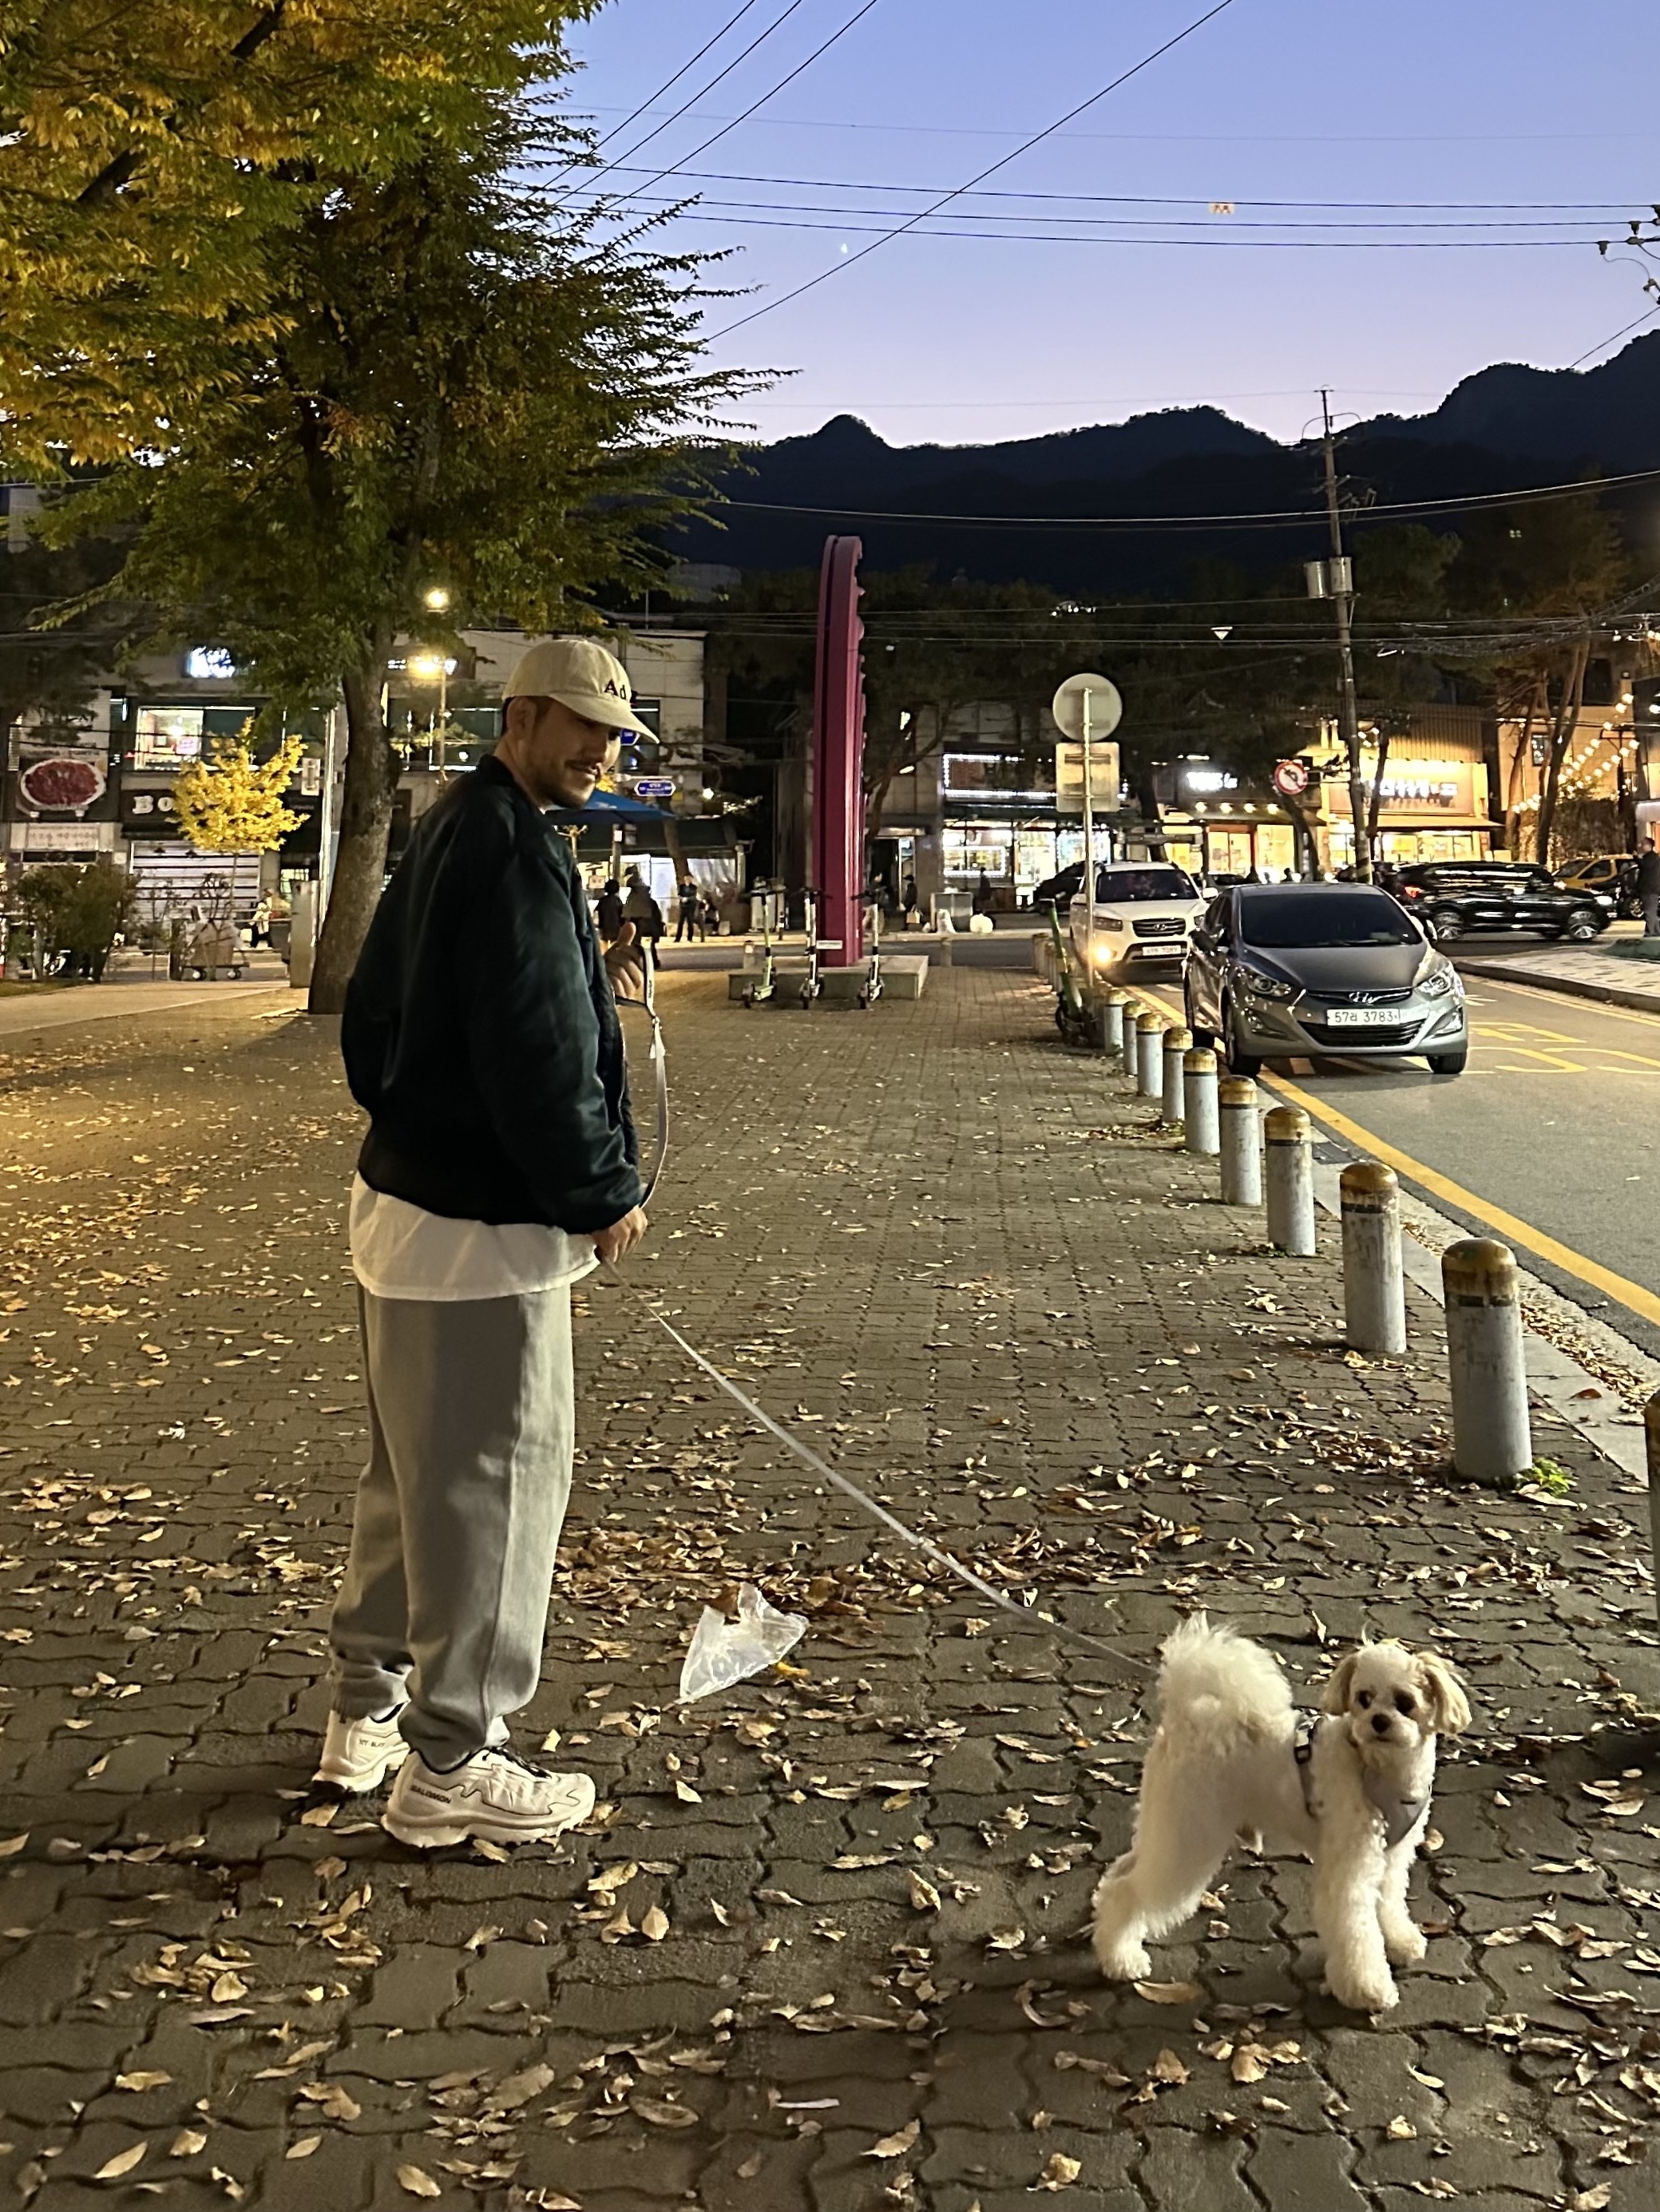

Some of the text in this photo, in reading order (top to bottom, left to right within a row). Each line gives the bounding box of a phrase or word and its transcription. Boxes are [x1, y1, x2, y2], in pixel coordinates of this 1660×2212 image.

[1334, 1010, 1393, 1023] 57러 3783
[410, 1785, 452, 1804] SALOMON
